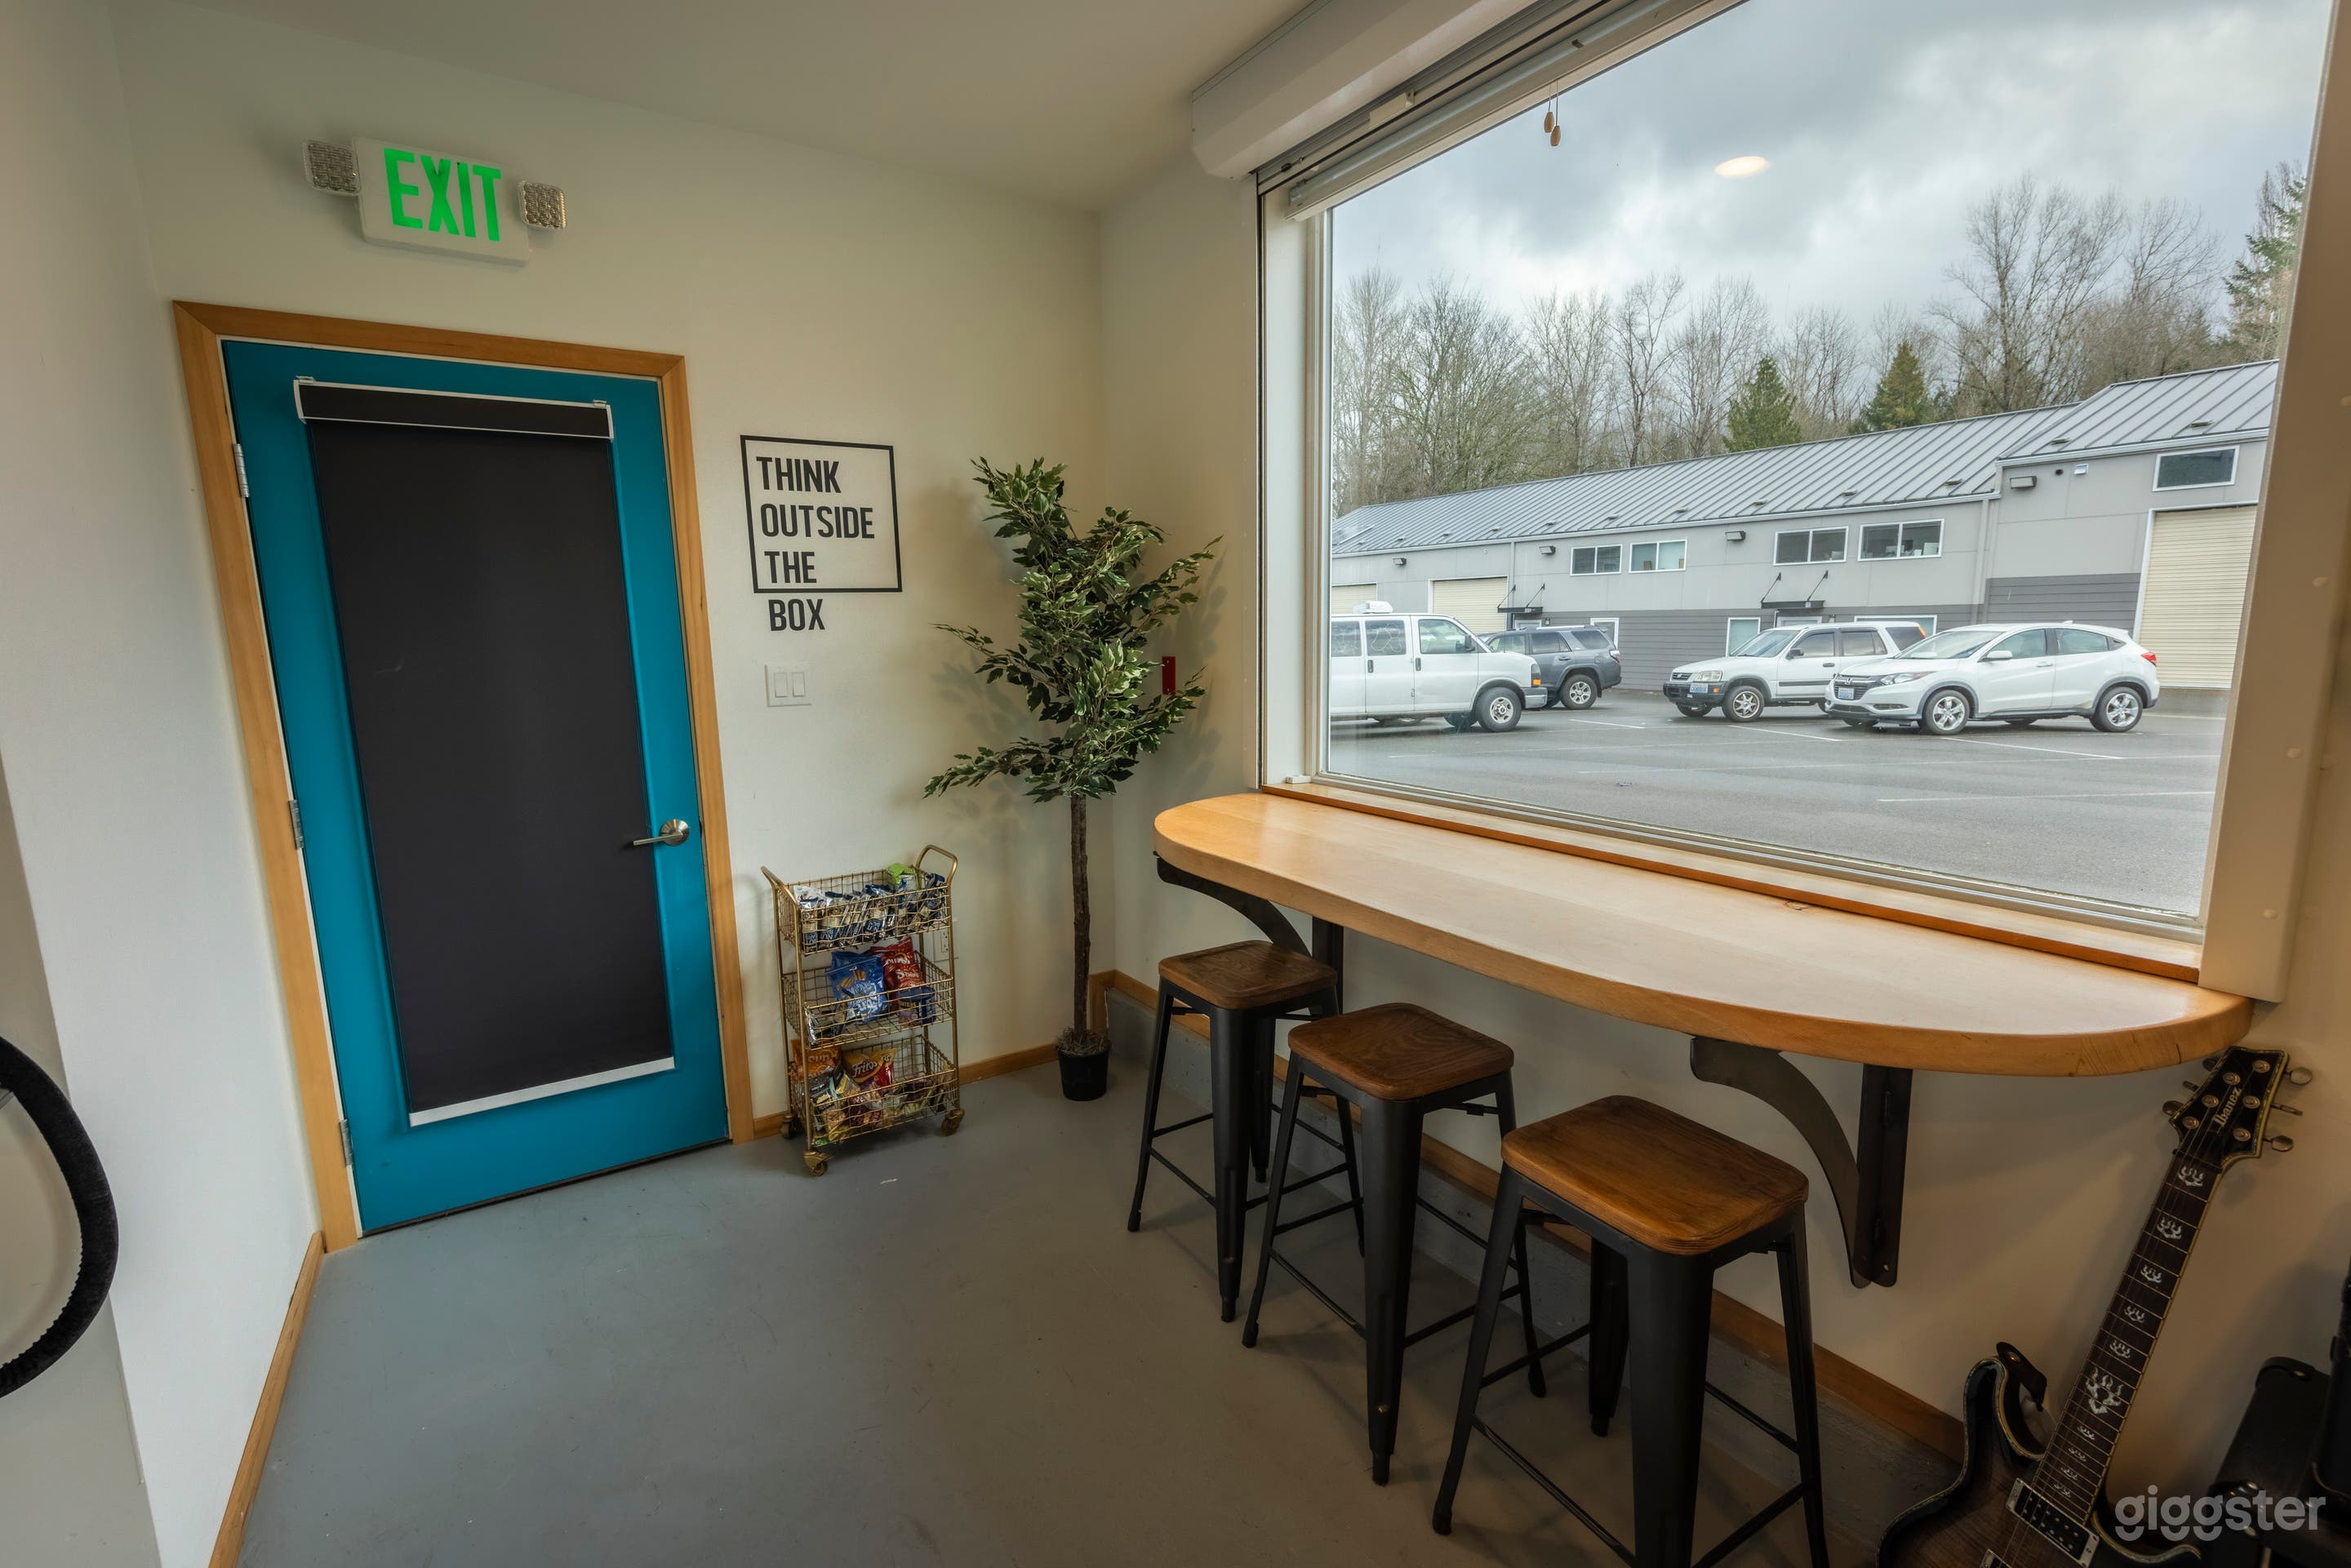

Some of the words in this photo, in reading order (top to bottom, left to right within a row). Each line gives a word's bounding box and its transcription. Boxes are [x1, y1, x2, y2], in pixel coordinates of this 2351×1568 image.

[384, 148, 502, 242] EXIT
[756, 456, 842, 494] THINK
[760, 503, 875, 539] OUTSIDE
[764, 551, 817, 584] THE
[768, 598, 826, 632] BOX
[2212, 1086, 2242, 1128] Ibanez
